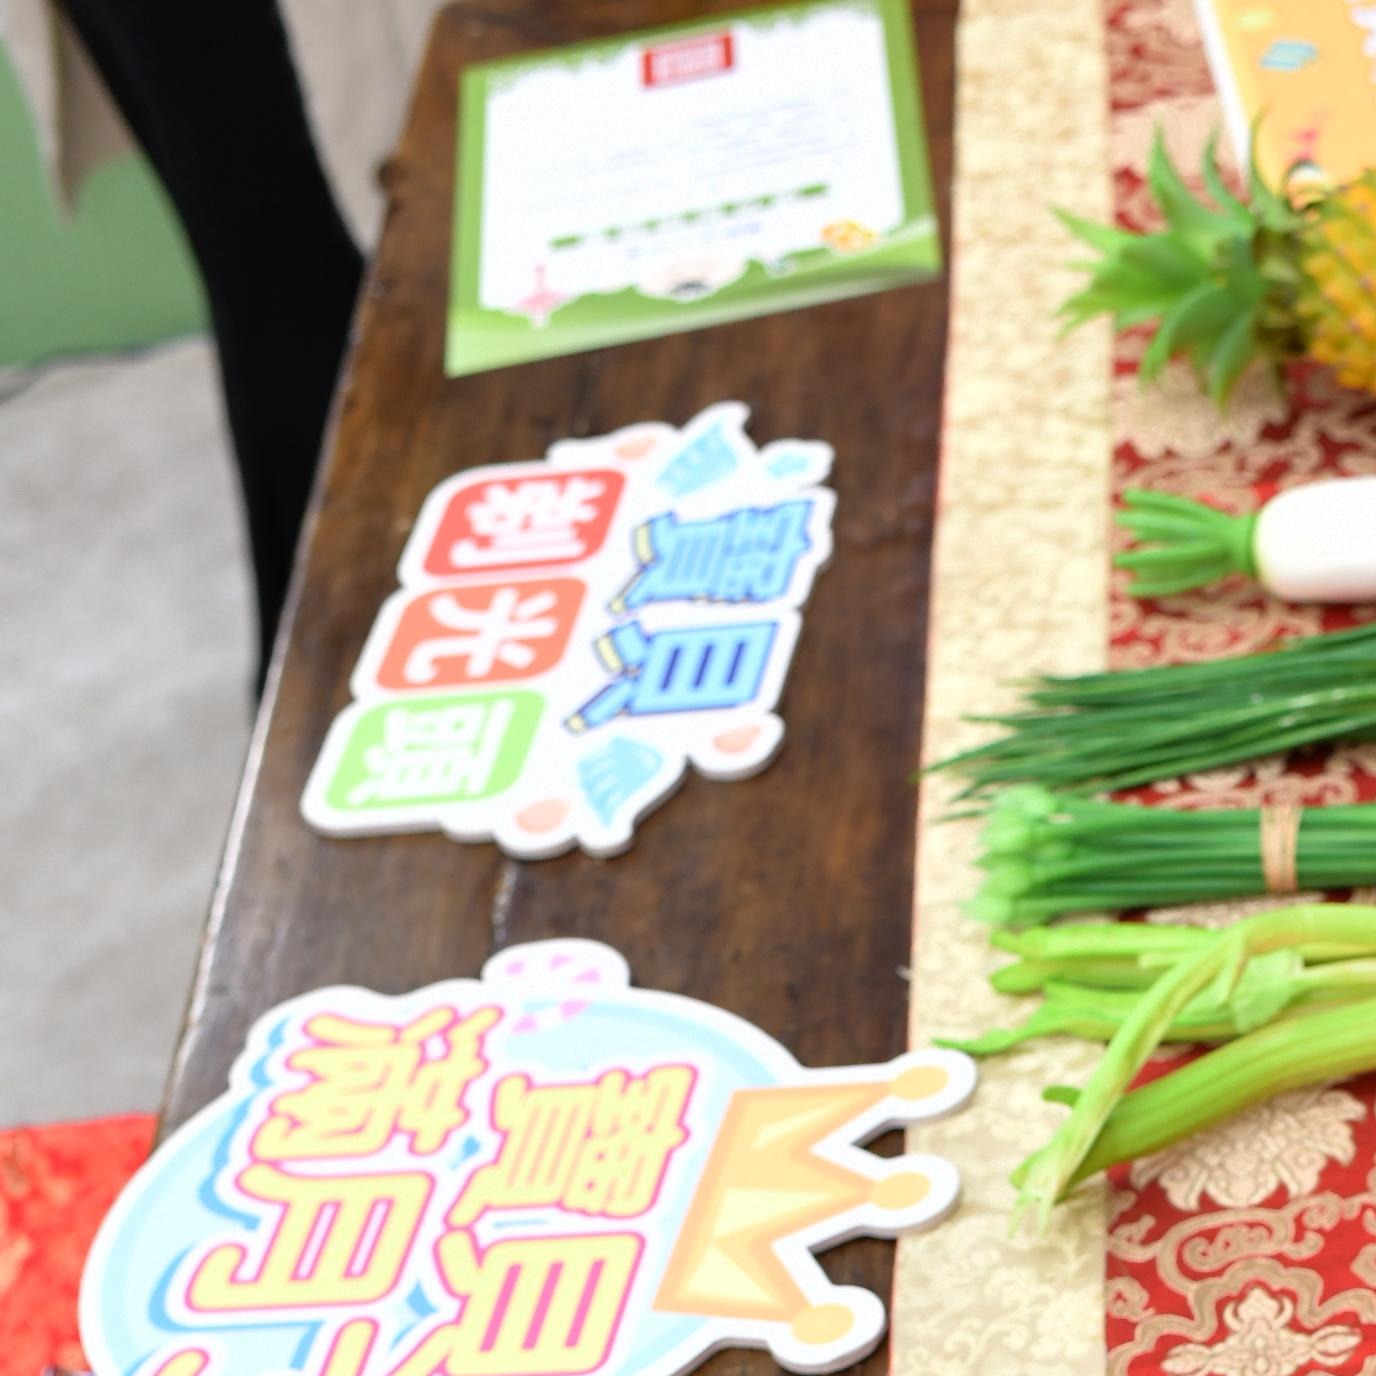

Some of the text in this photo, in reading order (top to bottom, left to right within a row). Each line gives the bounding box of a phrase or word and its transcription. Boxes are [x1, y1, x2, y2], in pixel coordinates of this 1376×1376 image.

[350, 477, 607, 804] 剃光頭
[565, 500, 814, 735] 寶貝
